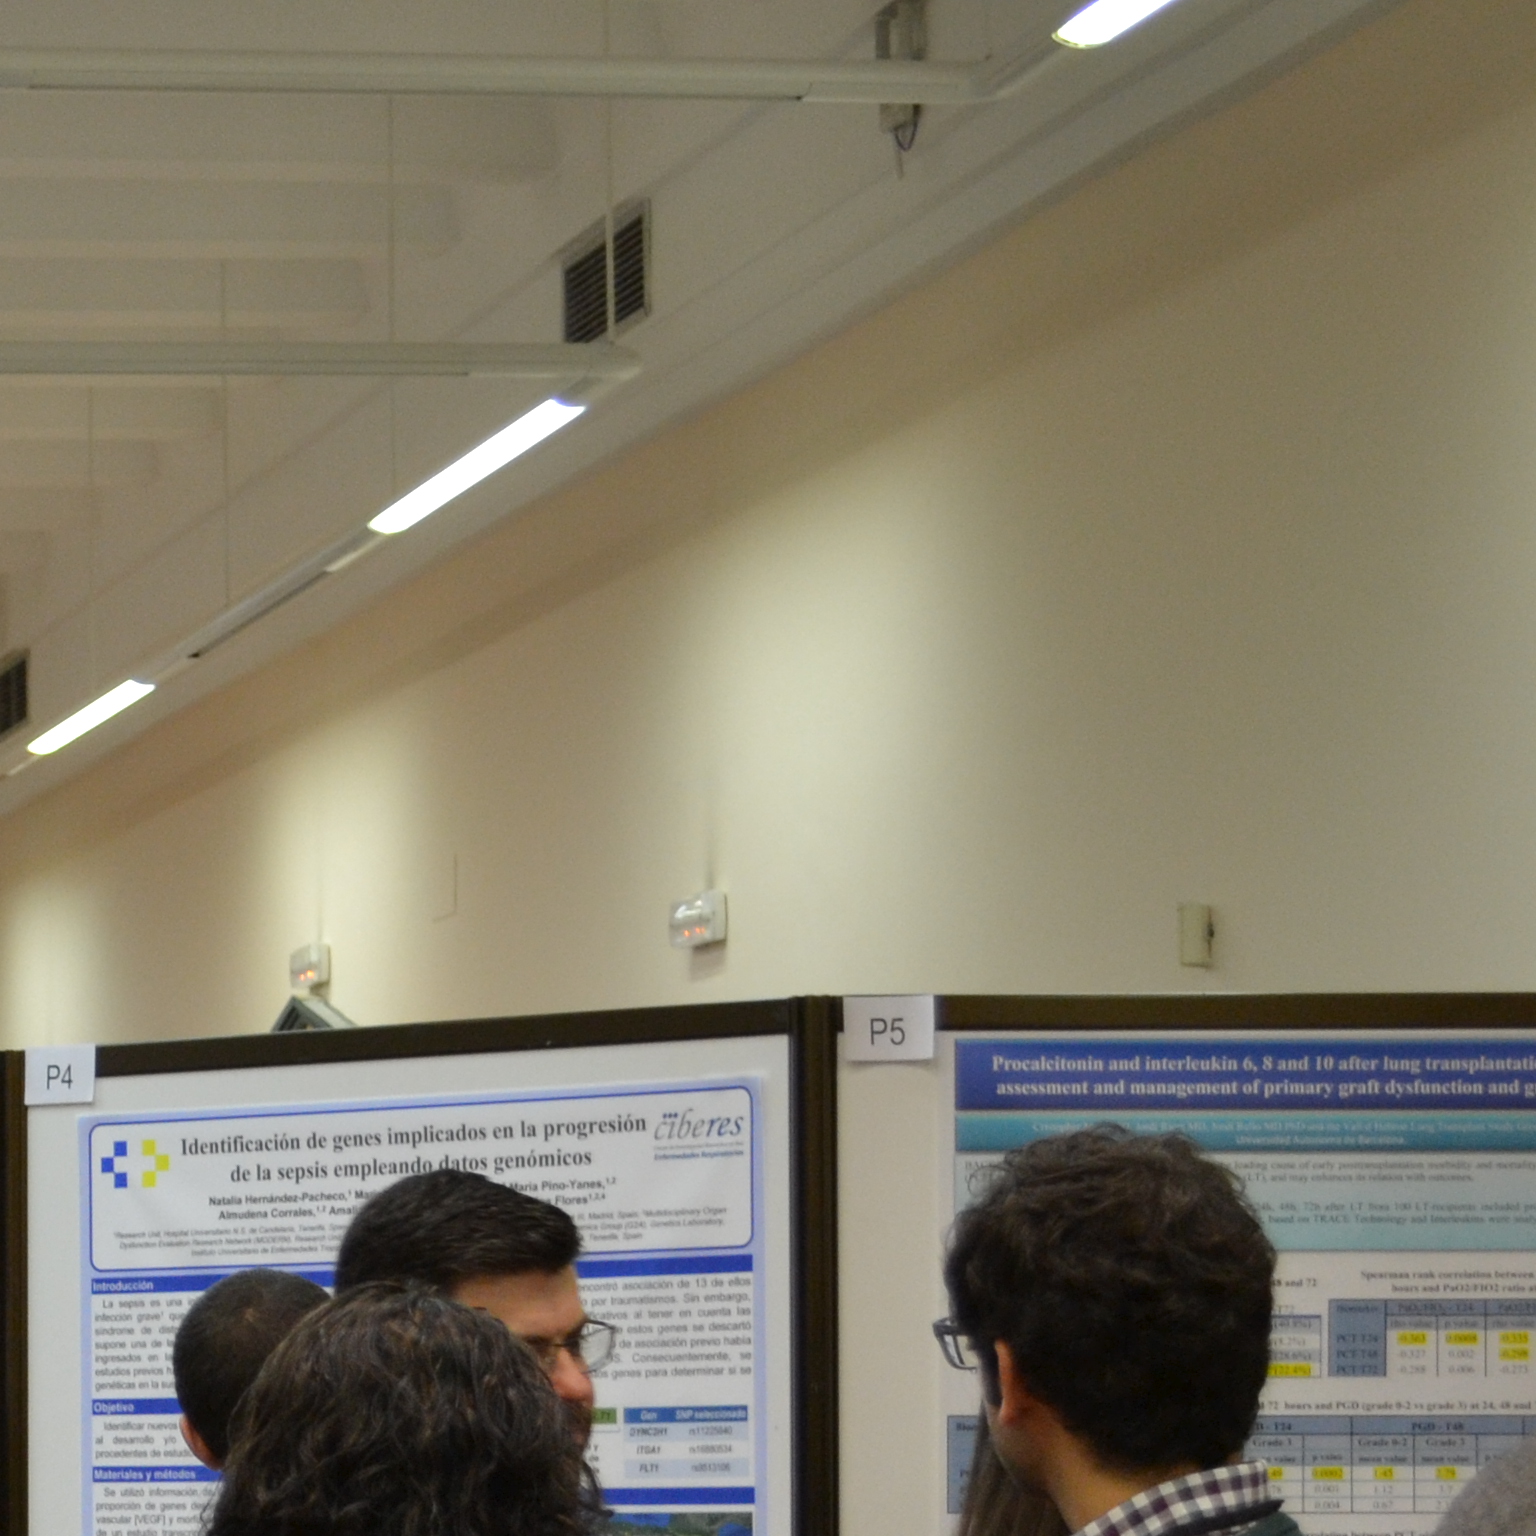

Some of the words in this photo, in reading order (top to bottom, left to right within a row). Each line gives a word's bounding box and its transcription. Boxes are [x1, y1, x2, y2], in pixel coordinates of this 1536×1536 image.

[869, 1017, 906, 1046] P5
[992, 1055, 1104, 1072] Procalcitonin
[1109, 1055, 1140, 1072] and
[1145, 1055, 1237, 1072] interleukin
[1243, 1056, 1258, 1073] 6,
[1262, 1056, 1273, 1071] 8
[1278, 1055, 1308, 1072] and
[1315, 1056, 1334, 1071] 10
[1338, 1055, 1378, 1072] after
[1383, 1055, 1420, 1075] lung
[1425, 1055, 1536, 1075] transplantati
[46, 1064, 74, 1091] P4
[996, 1080, 1089, 1095] assessment
[1093, 1080, 1125, 1095] and
[1130, 1081, 1238, 1098] management
[1243, 1079, 1261, 1095] of
[1264, 1080, 1333, 1099] primary
[1338, 1079, 1380, 1099] graft
[1384, 1079, 1483, 1099] dysfunction
[1488, 1079, 1520, 1095] and
[181, 1133, 301, 1156] Identificación
[306, 1131, 328, 1150] de
[332, 1134, 382, 1153] genes
[387, 1120, 487, 1148] implicados
[493, 1124, 514, 1140] en
[520, 1119, 537, 1138] la
[543, 1114, 647, 1142] progresión
[230, 1164, 251, 1183] de
[256, 1163, 272, 1182] la
[277, 1161, 328, 1185] sepsis
[333, 1156, 432, 1182] empleando
[438, 1153, 488, 1171] datos
[494, 1148, 592, 1174] genómicos
[208, 1194, 243, 1207] Natalia
[218, 1208, 268, 1221] Almudena
[93, 1280, 153, 1291] Introducción
[677, 1280, 690, 1289] de
[696, 1278, 707, 1288] 13
[711, 1278, 724, 1288] de
[728, 1276, 751, 1287] ellos
[591, 1297, 607, 1307] por
[683, 1293, 700, 1303] Sin
[131, 1341, 147, 1349] una
[151, 1340, 162, 1348] de
[151, 1381, 159, 1389] la
[93, 1402, 135, 1413] Objetivo
[94, 1469, 144, 1480] Materiales
[146, 1470, 152, 1481] y
[154, 1468, 196, 1480] métodos
